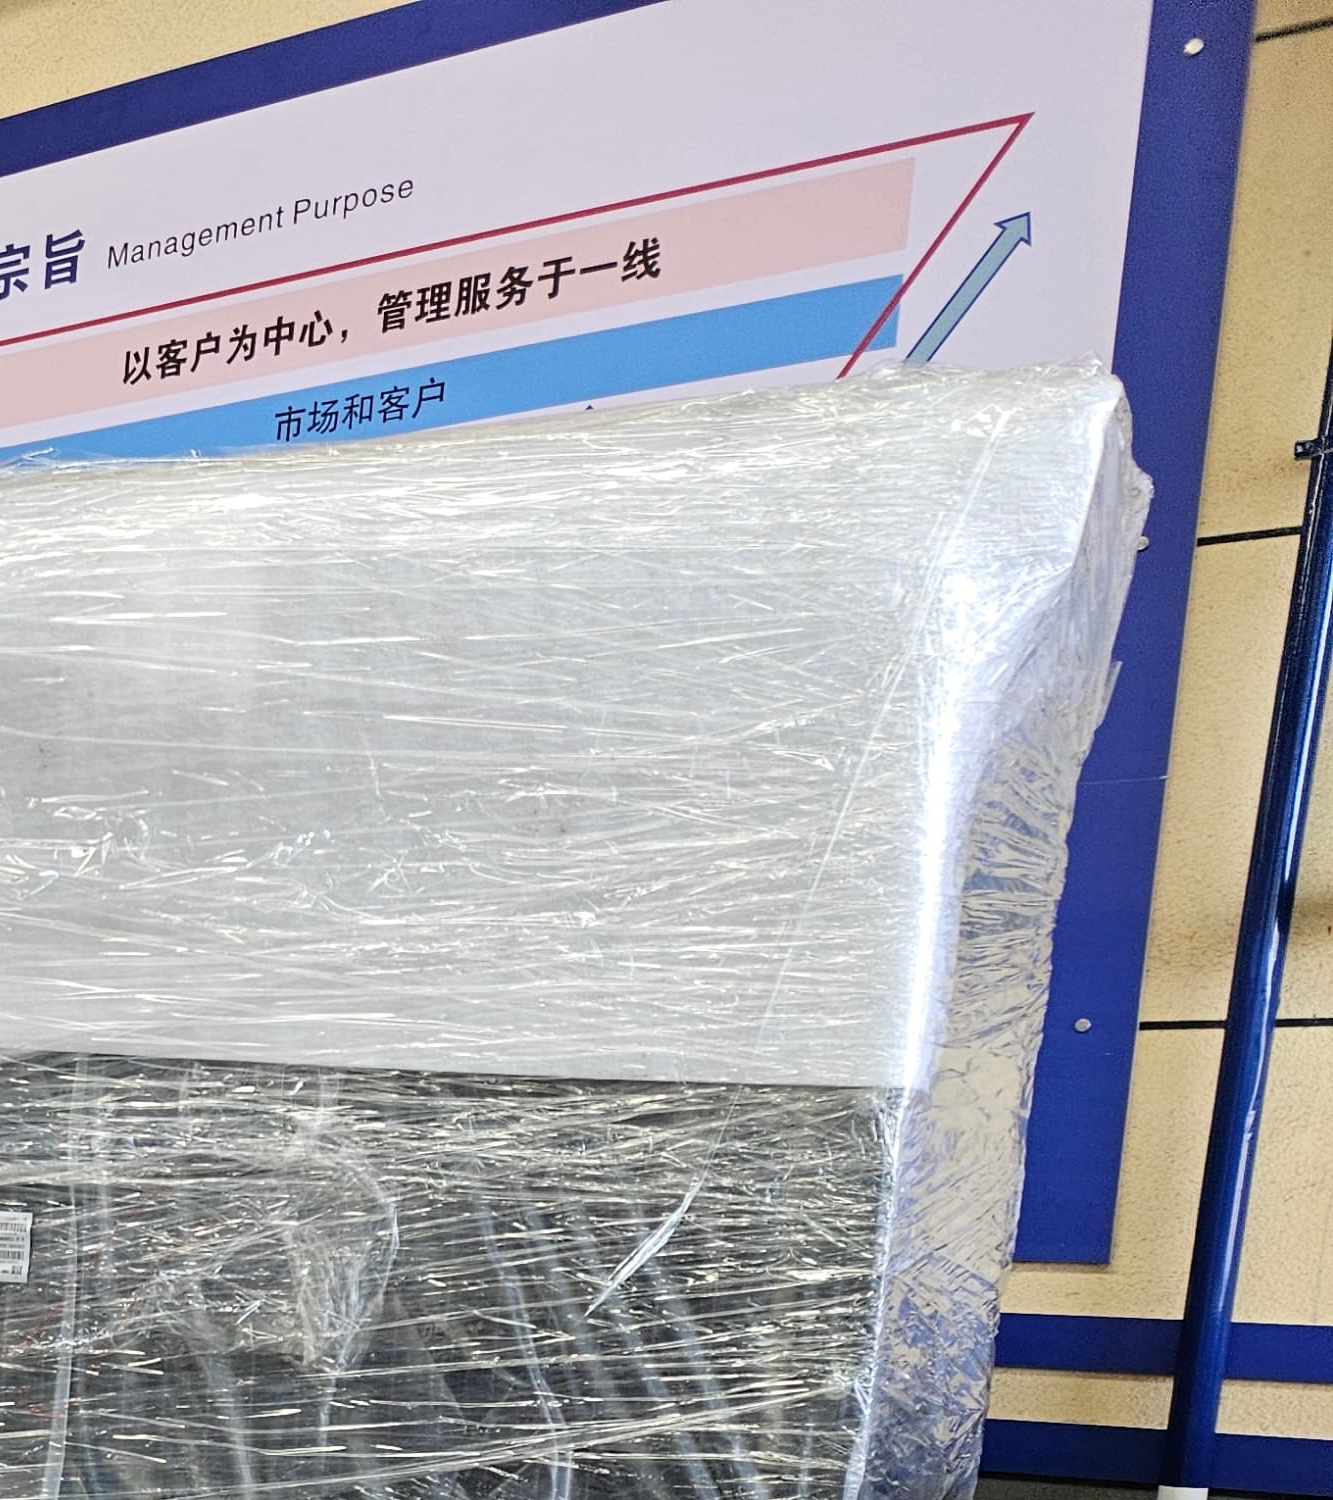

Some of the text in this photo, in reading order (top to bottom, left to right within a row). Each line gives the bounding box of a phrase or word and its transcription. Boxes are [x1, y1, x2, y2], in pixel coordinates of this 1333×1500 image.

[108, 180, 413, 269] Management Purpose
[275, 378, 445, 441] 市场和客户
